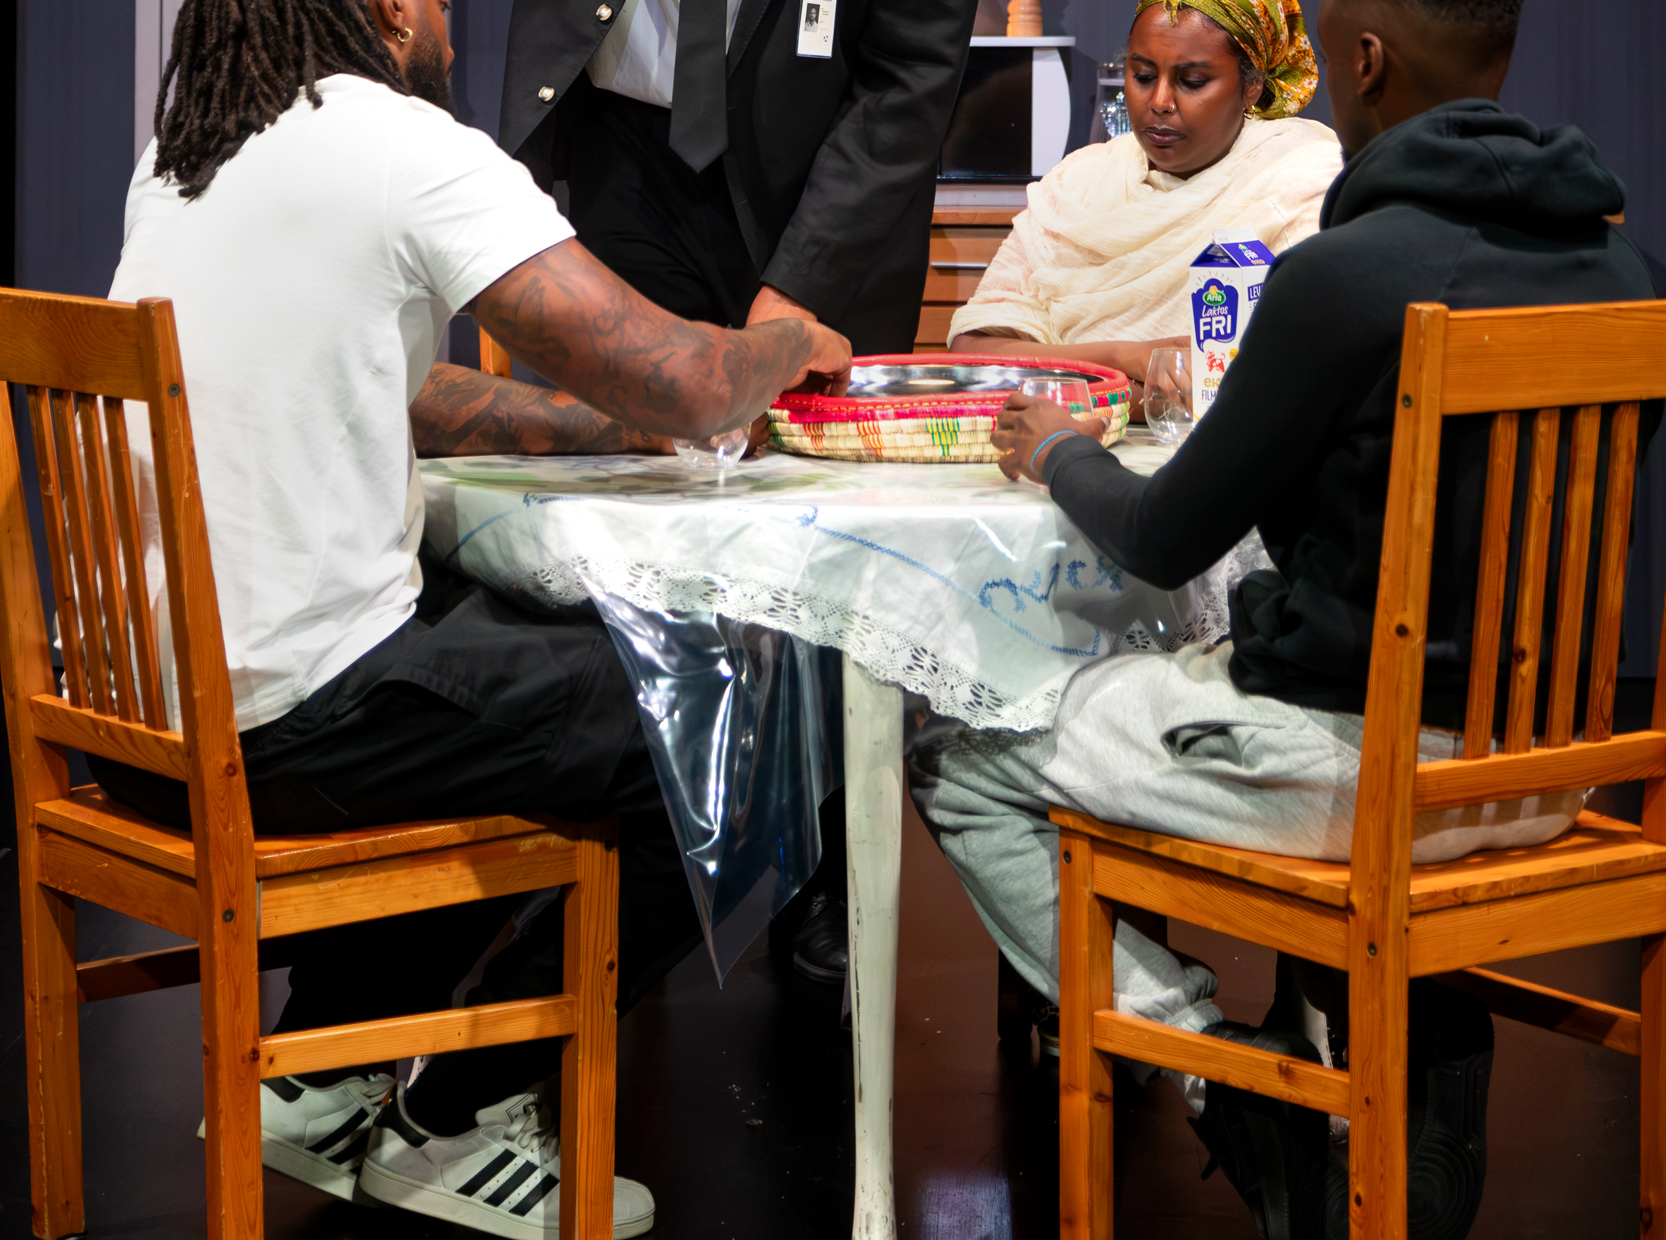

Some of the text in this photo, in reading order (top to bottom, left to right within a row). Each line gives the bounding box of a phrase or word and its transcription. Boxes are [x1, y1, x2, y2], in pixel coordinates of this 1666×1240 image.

[1249, 284, 1262, 299] LEV
[1206, 294, 1222, 302] Arla
[1202, 305, 1229, 318] Laktos
[1199, 314, 1232, 341] FRI
[1203, 377, 1220, 388] ek
[1201, 389, 1217, 401] FILM
